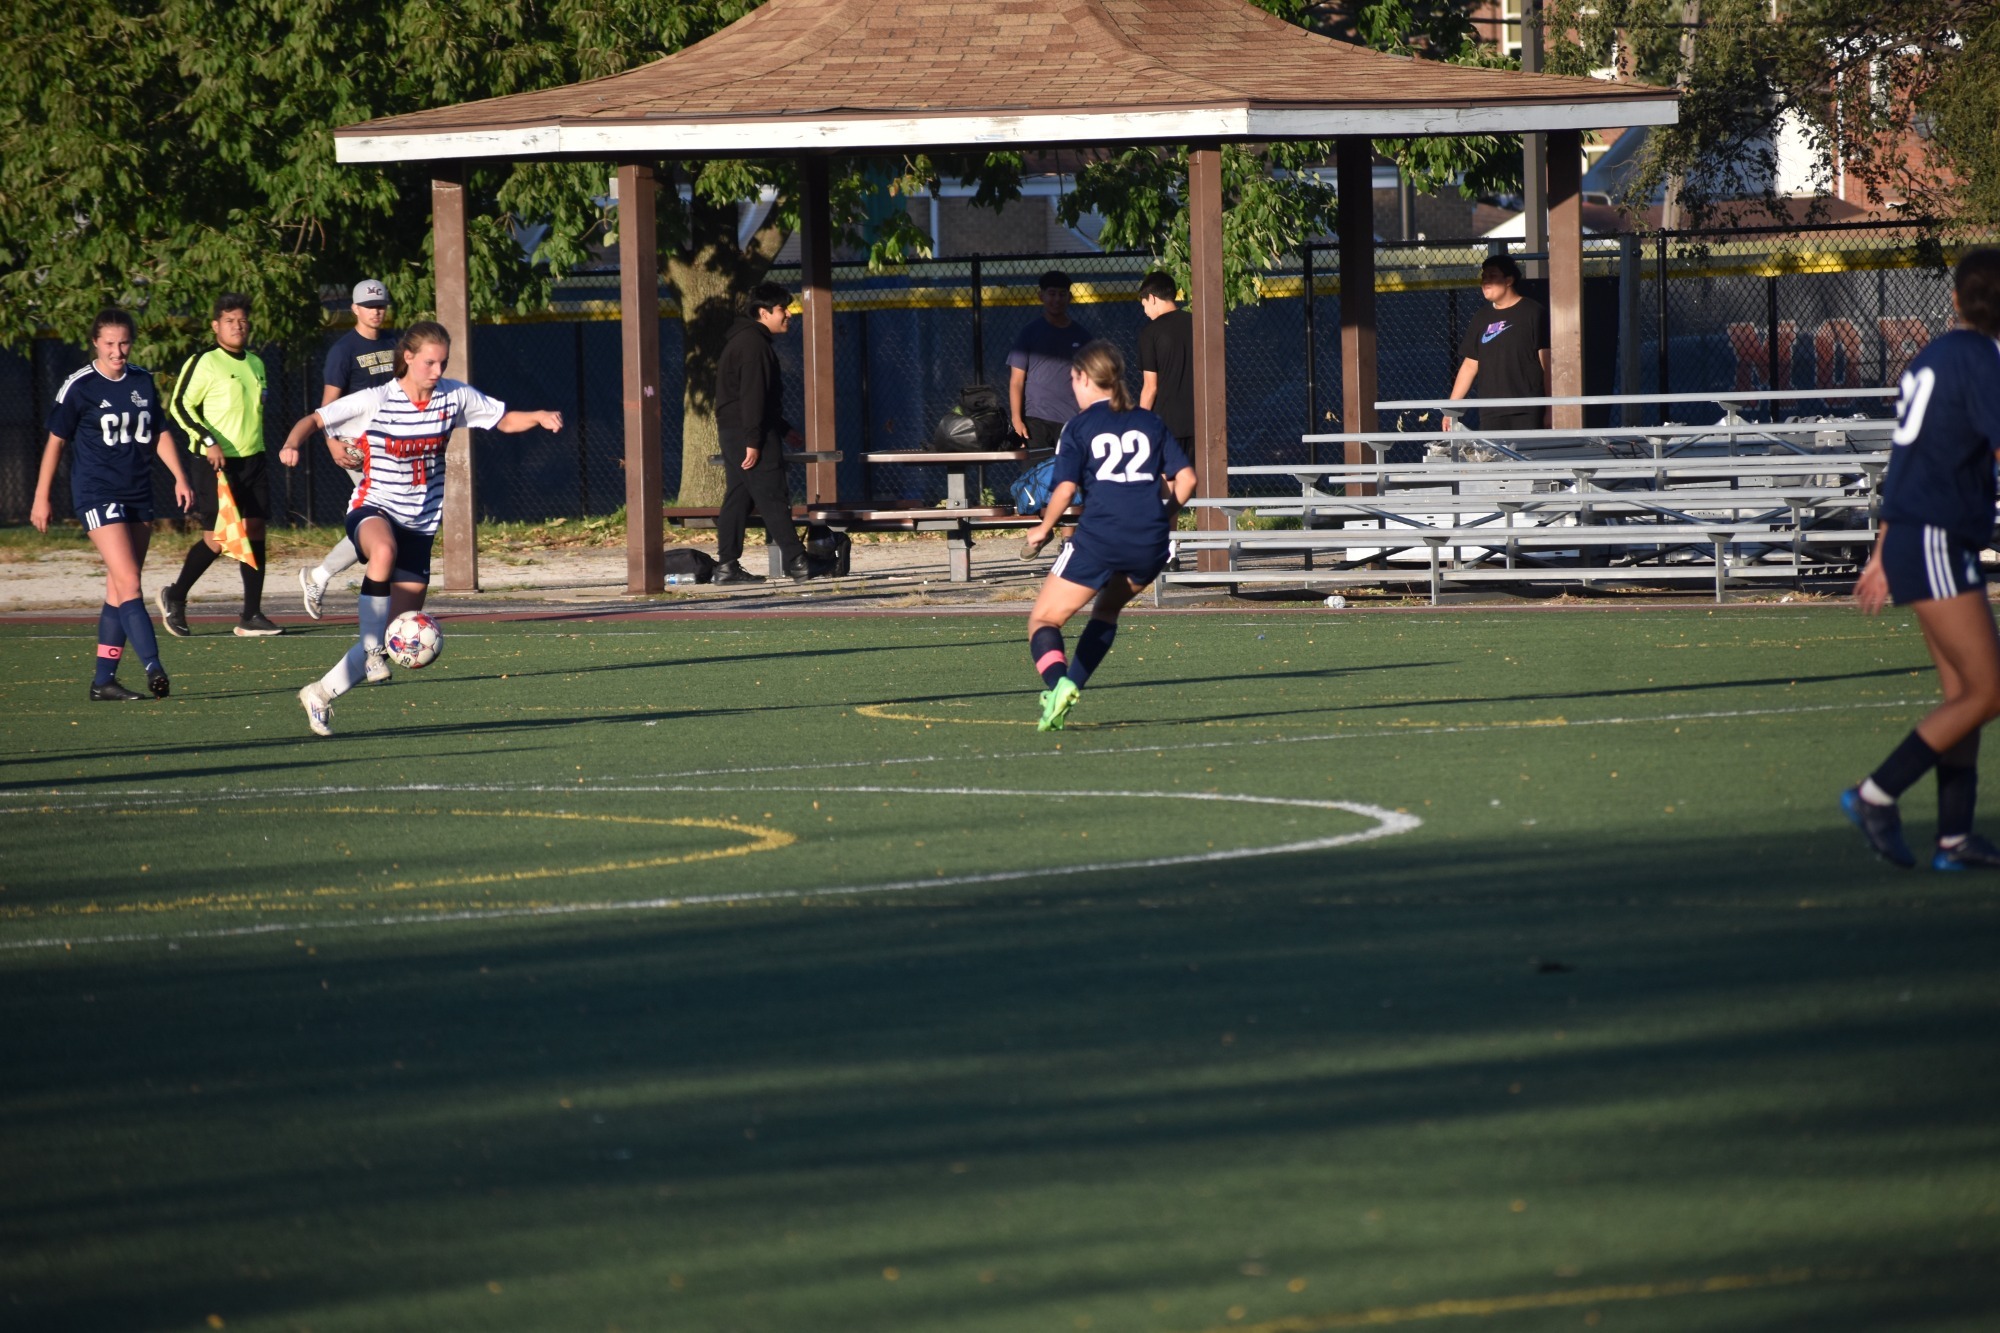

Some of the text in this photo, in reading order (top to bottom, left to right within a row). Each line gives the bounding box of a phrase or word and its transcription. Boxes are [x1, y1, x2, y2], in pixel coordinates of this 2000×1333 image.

[100, 410, 152, 446] CLC
[1091, 429, 1154, 483] 22
[108, 648, 119, 657] C
